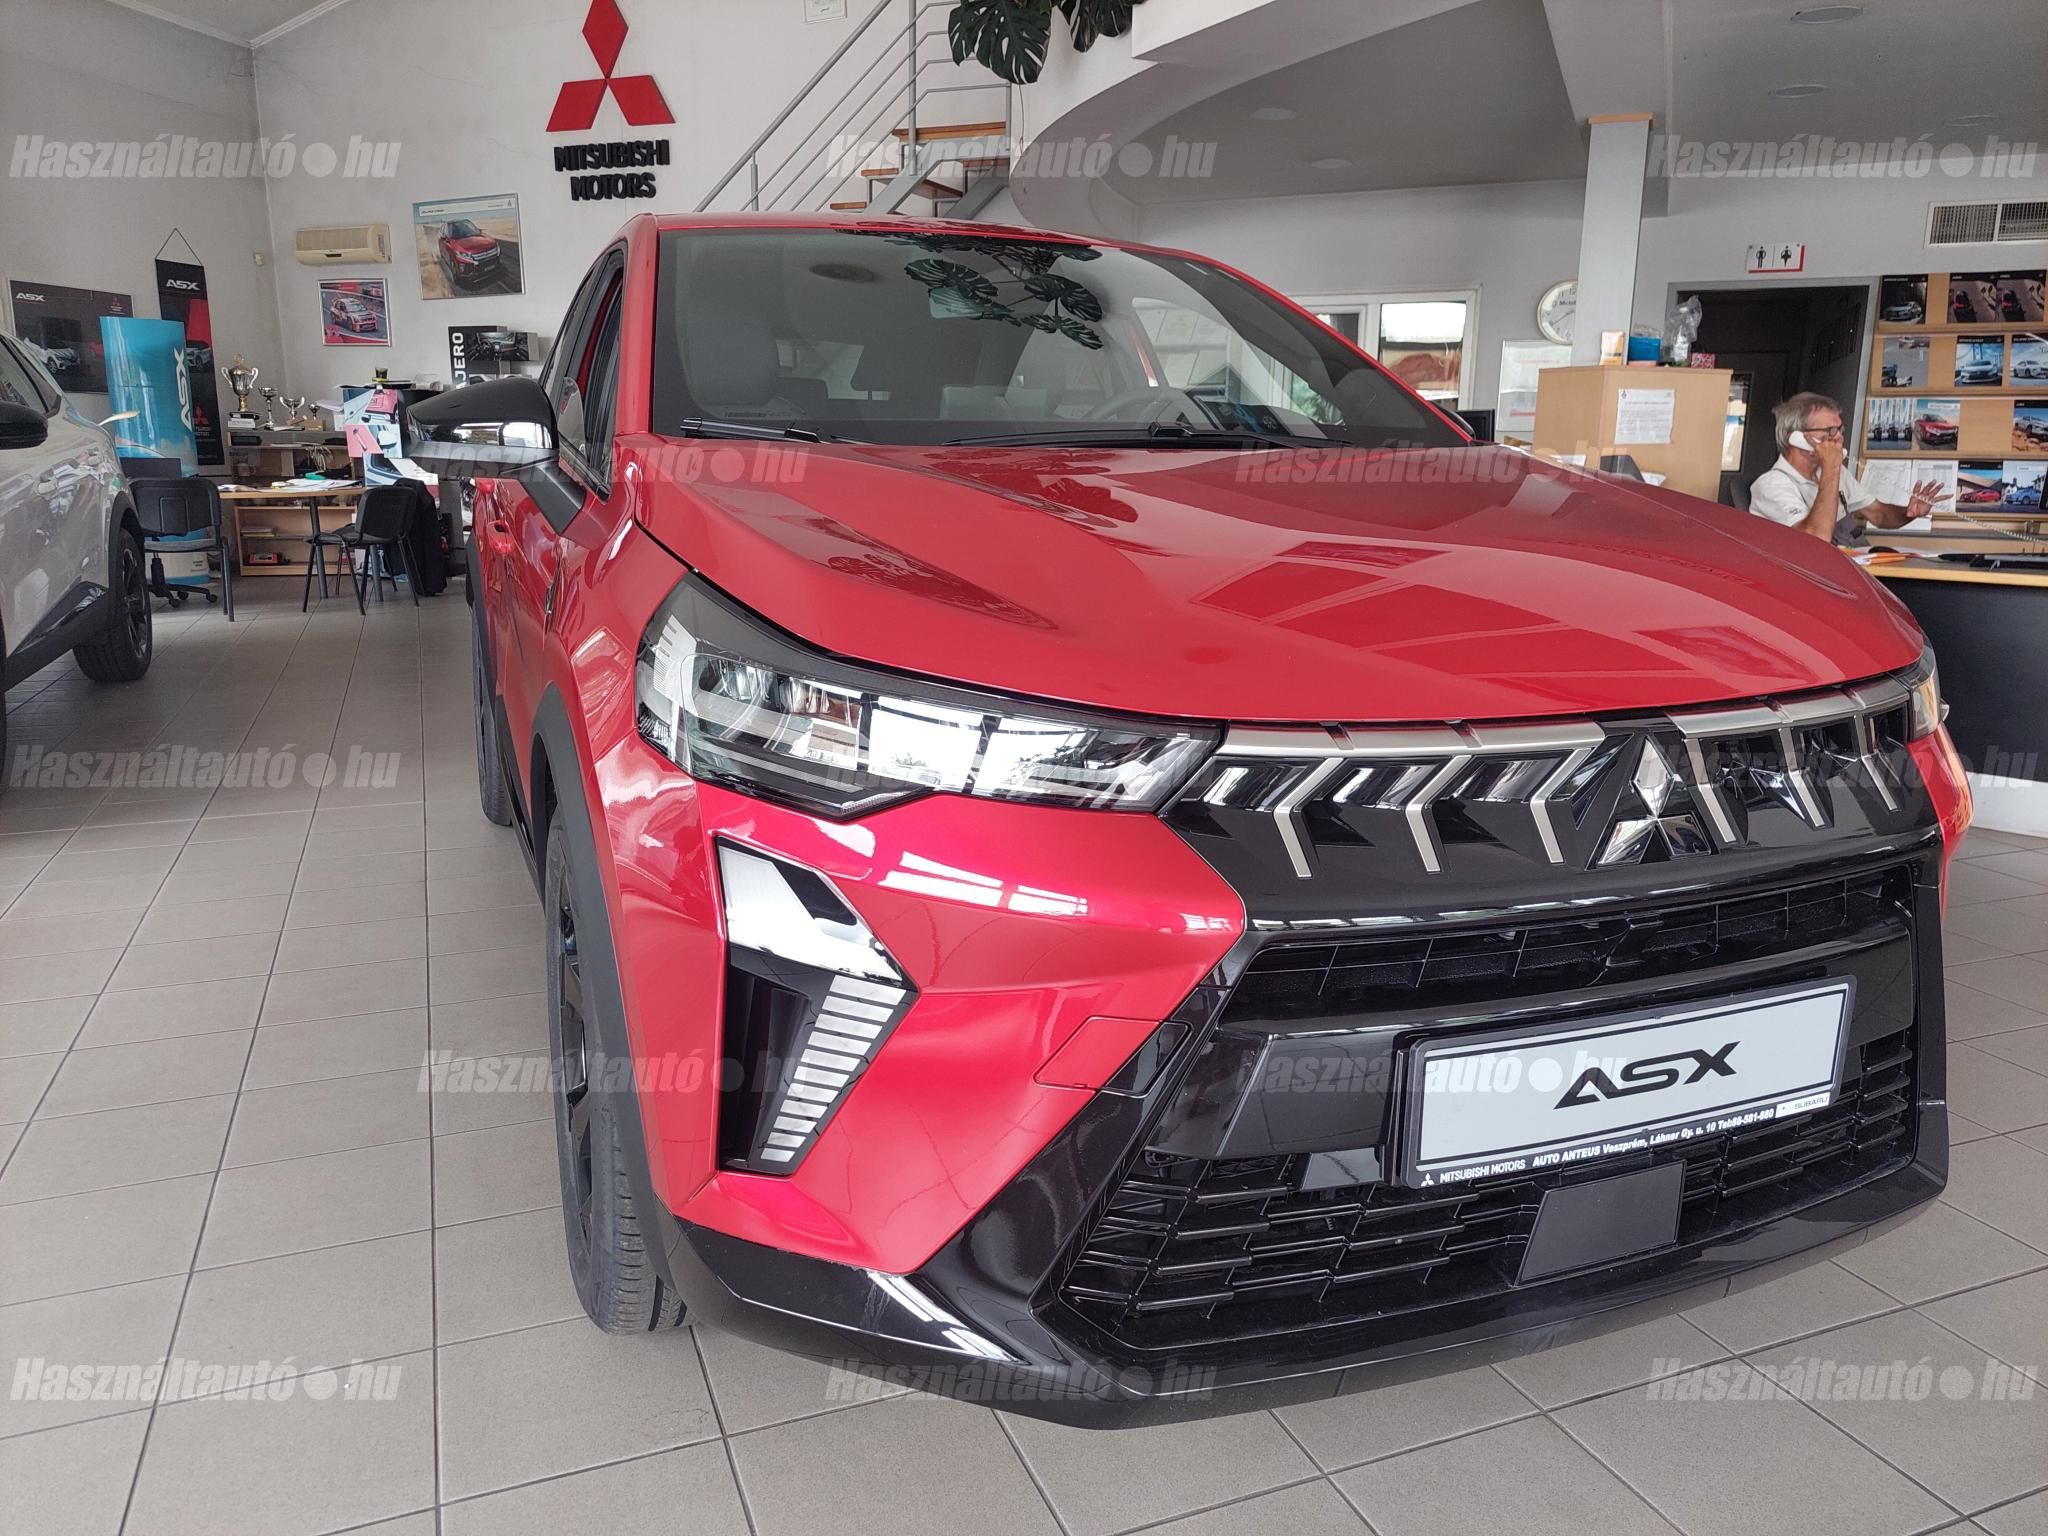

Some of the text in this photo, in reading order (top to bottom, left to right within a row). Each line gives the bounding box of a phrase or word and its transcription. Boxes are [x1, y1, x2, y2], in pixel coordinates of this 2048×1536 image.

[554, 139, 670, 172] MITSUBISHI
[570, 172, 657, 201] MOTORS
[15, 292, 45, 302] ASX
[166, 279, 200, 291] ASX
[452, 332, 467, 389] AJERO
[174, 347, 193, 432] ASX
[1553, 1041, 1741, 1110] ASX
[1439, 1164, 1489, 1184] MITSUBISHI
[1490, 1159, 1526, 1175] MOTORS
[1532, 1154, 1560, 1167] AUTO
[1561, 1145, 1601, 1162] ANTEUS
[1649, 1131, 1680, 1145] Láhner
[1706, 1122, 1716, 1133] 10
[1794, 1097, 1828, 1110] SUBARU
